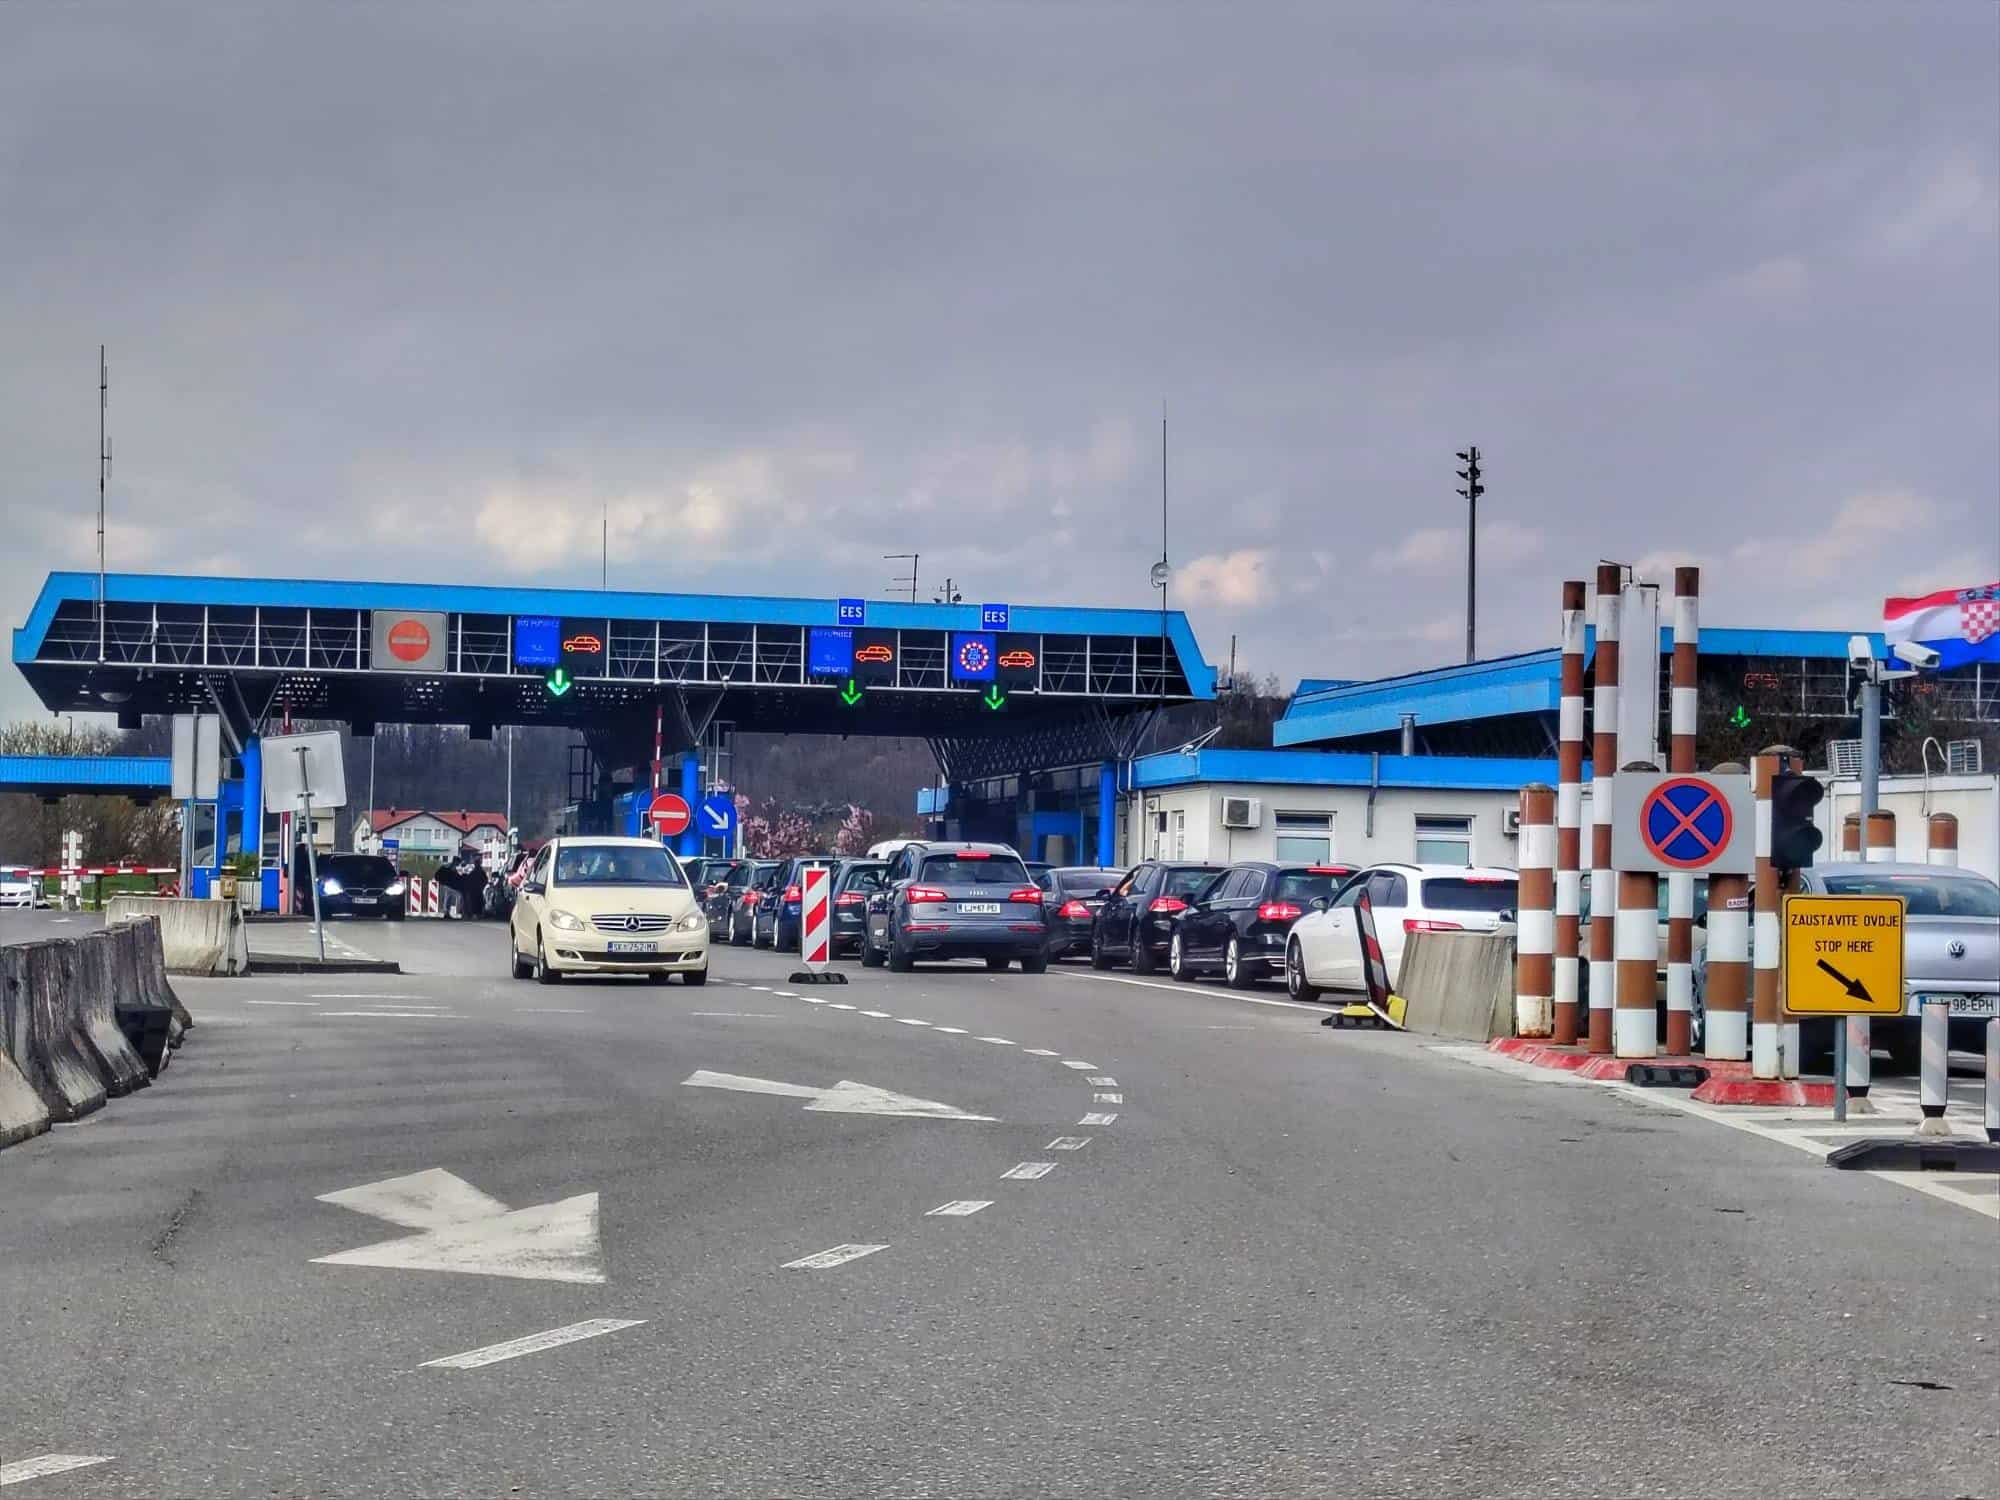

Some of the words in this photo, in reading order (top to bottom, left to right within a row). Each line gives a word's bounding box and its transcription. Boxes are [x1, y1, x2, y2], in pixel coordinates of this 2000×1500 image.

[840, 606, 863, 618] EES
[984, 611, 1006, 623] EES
[1791, 914, 1858, 926] ZAUSTAVITE
[1863, 915, 1900, 927] OVDJE
[1815, 940, 1842, 952] STOP
[1847, 941, 1874, 953] HERE
